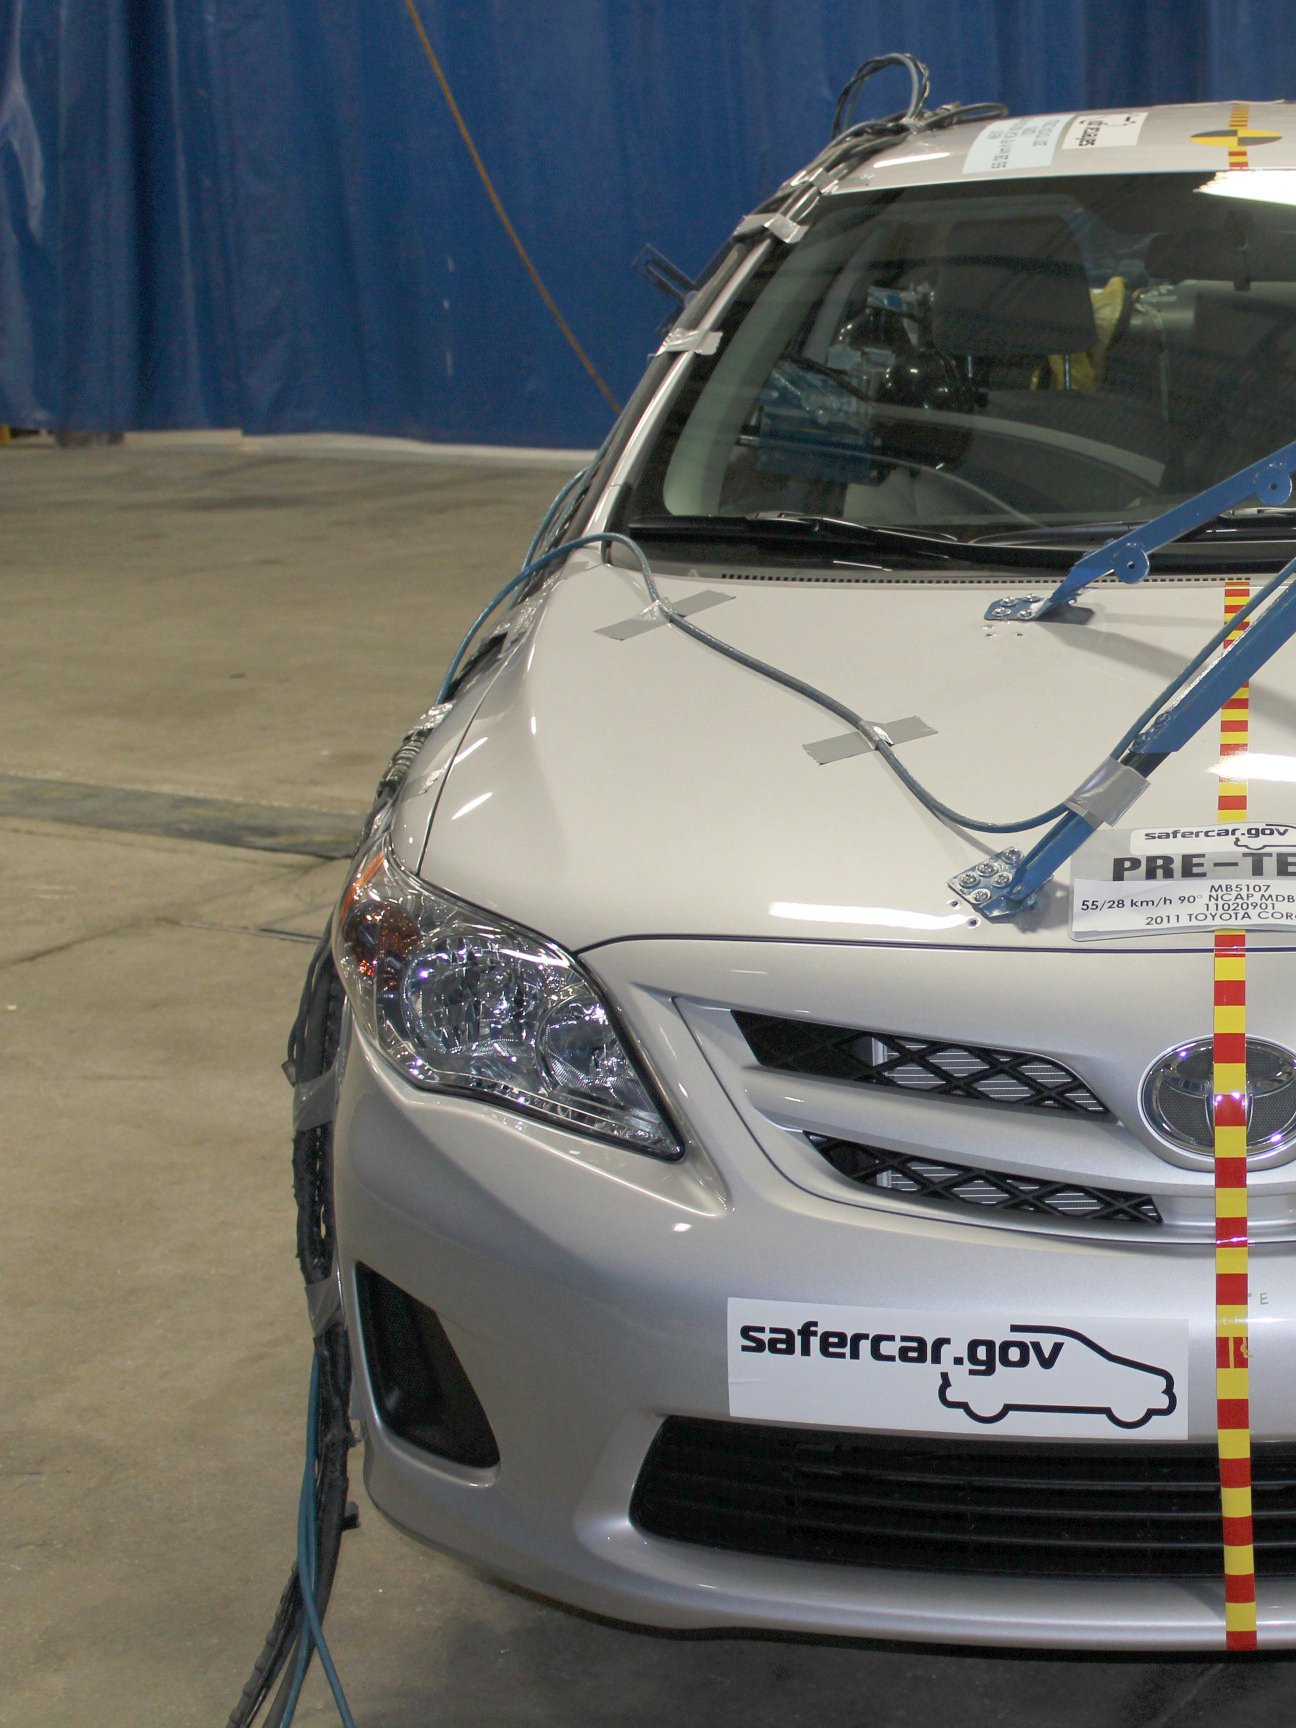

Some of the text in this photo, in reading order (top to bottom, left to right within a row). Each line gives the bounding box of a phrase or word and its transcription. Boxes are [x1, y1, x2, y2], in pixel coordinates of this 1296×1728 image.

[1144, 826, 1289, 840] safercar.gov
[1210, 884, 1271, 893] MB5107
[1081, 899, 1125, 911] 55/28
[1131, 896, 1172, 908] km/h
[1209, 893, 1254, 902] NCAP
[1260, 894, 1295, 903] MDB
[1205, 902, 1275, 912] 11020901
[1145, 915, 1180, 926] 2011
[1187, 911, 1252, 922] TOYOTA
[740, 1321, 1065, 1376] safercar.gov
